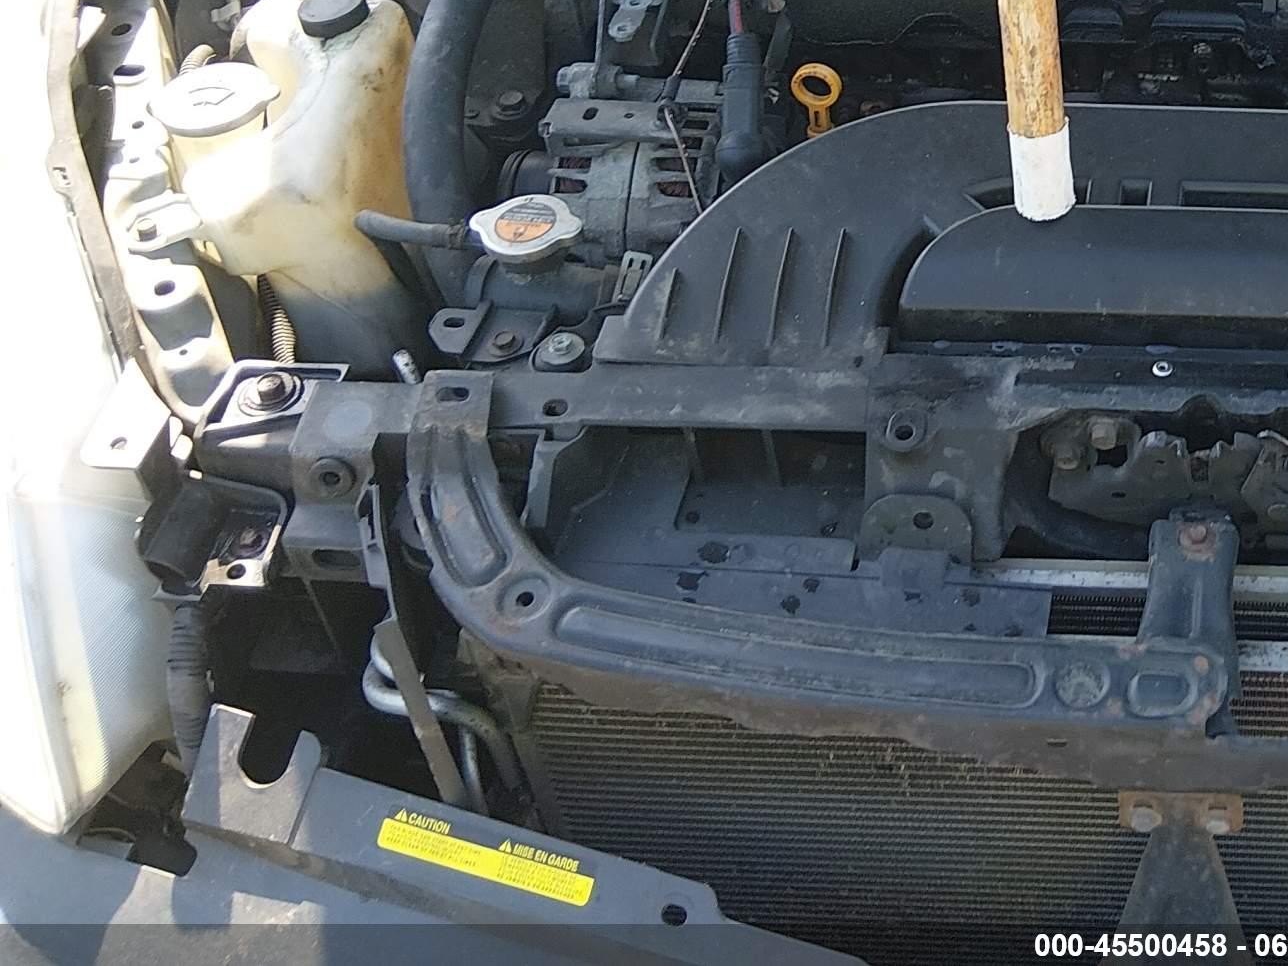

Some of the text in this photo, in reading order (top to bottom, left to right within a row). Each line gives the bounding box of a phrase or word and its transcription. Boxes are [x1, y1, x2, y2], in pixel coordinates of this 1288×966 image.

[408, 813, 451, 835] CAUTION
[512, 843, 579, 872] MISE EN GARDE
